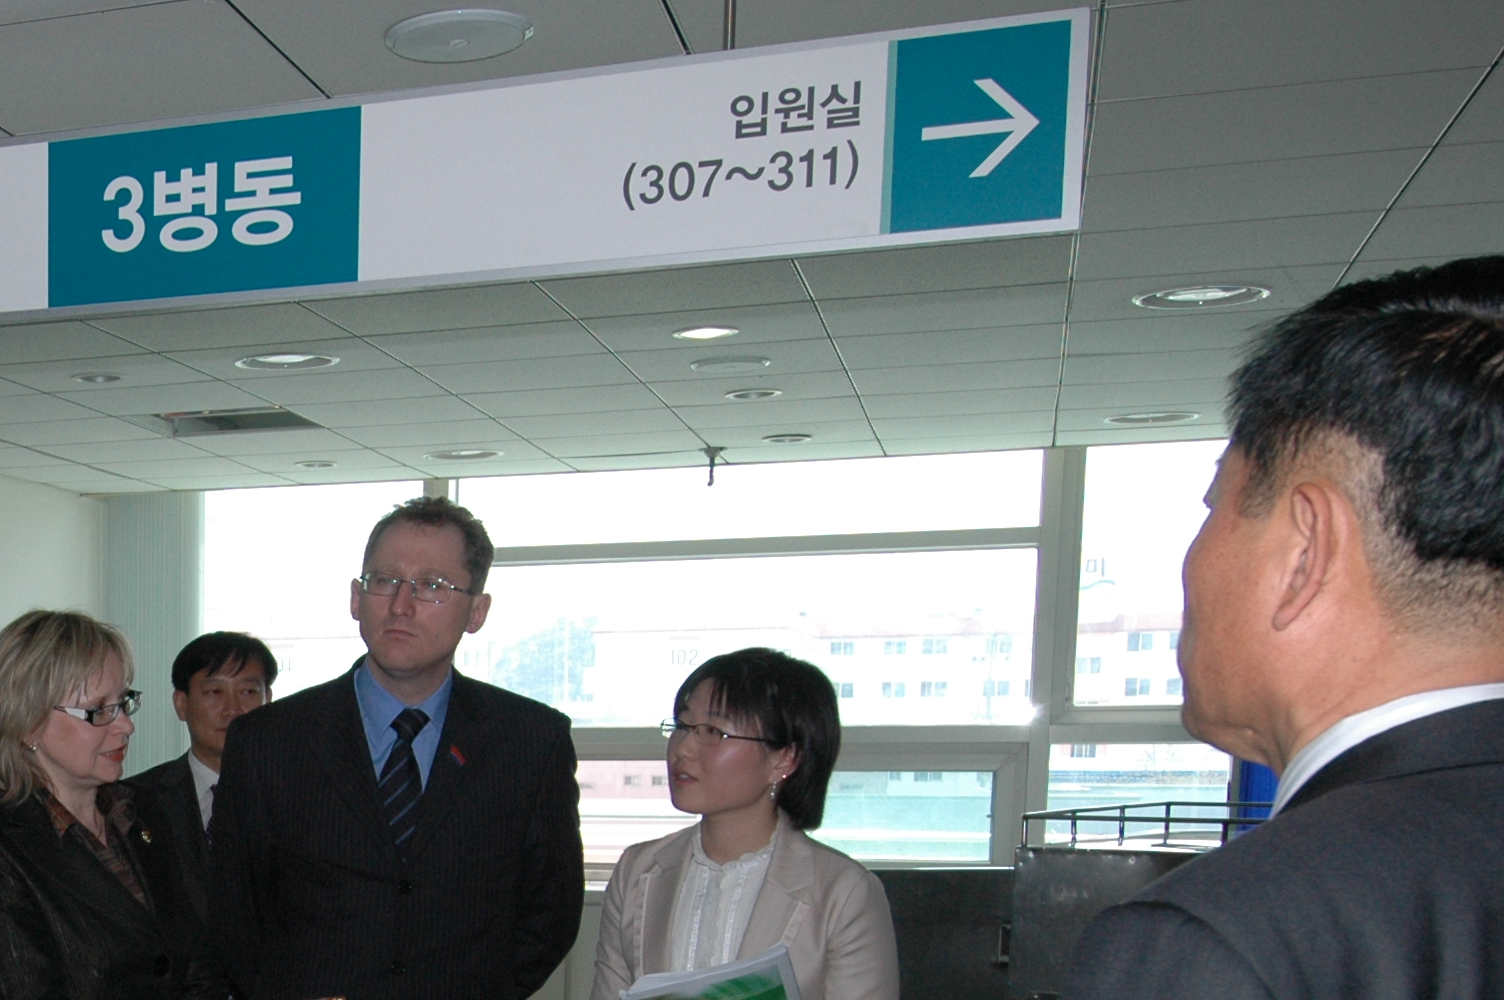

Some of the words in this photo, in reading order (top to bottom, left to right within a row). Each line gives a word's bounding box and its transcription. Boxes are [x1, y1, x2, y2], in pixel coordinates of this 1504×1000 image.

[730, 80, 862, 140] 입원실
[101, 155, 302, 253] 3병동
[623, 139, 859, 211] (307~311)
[670, 648, 699, 666] 102
